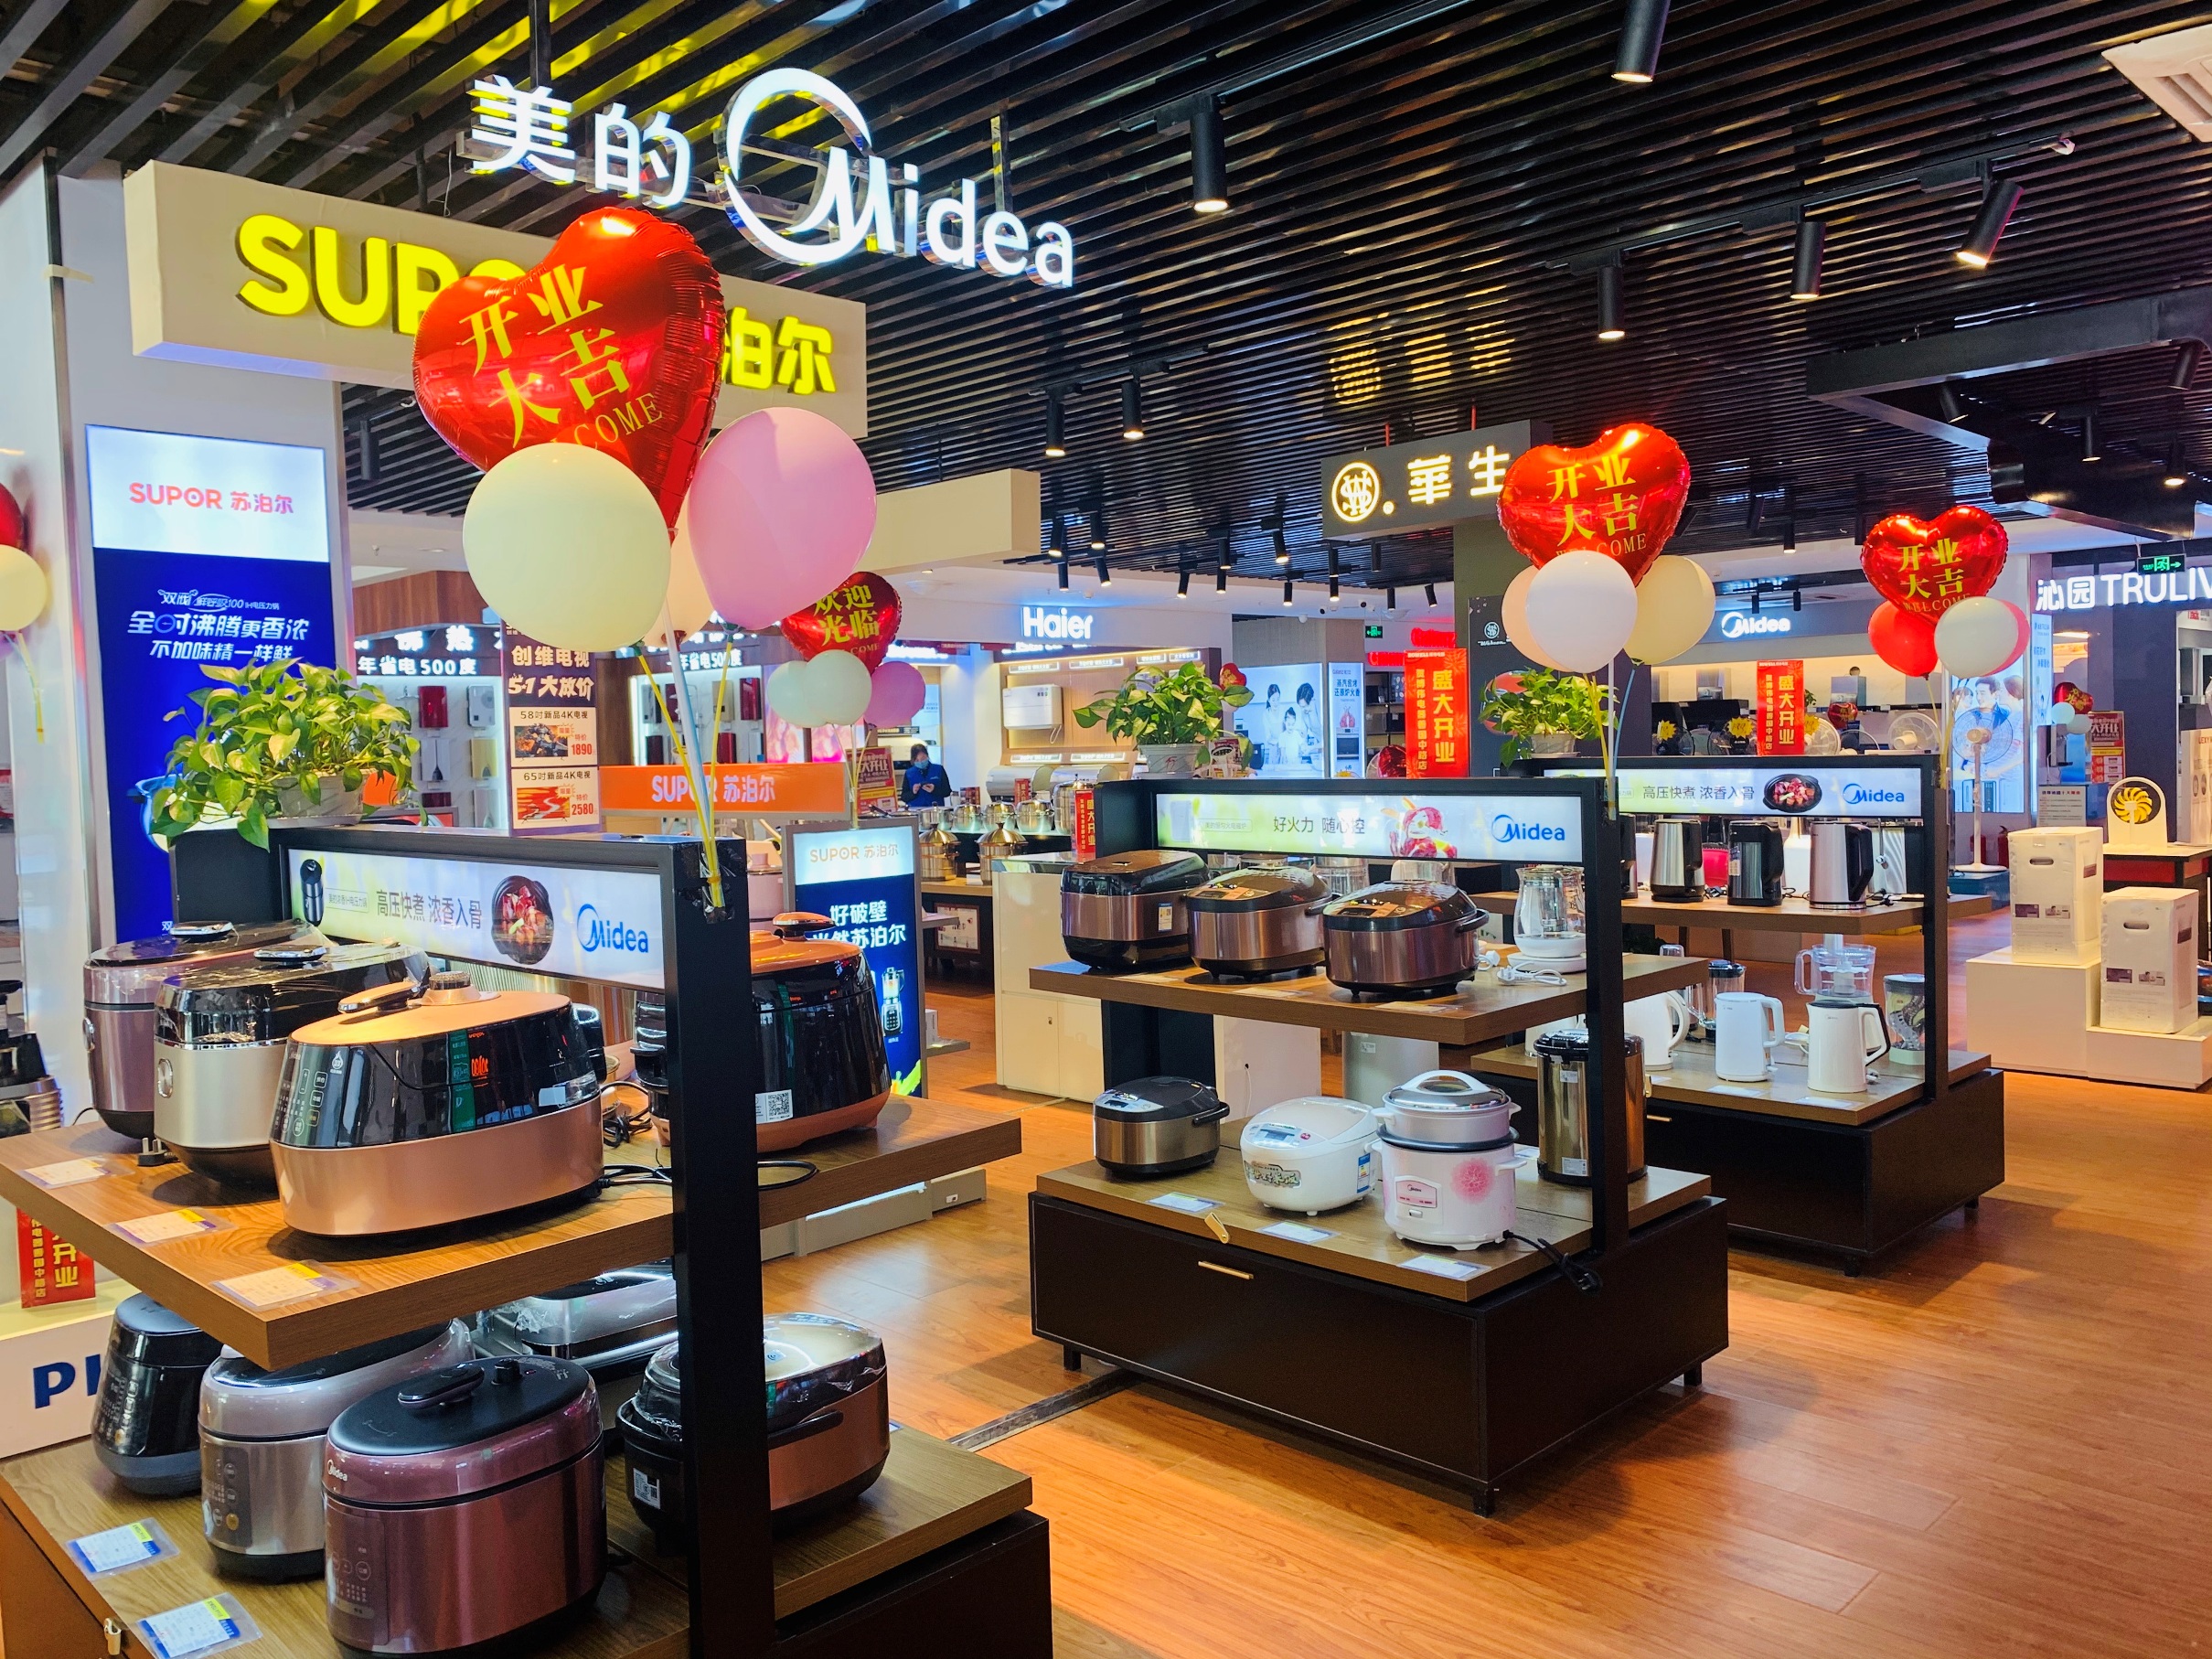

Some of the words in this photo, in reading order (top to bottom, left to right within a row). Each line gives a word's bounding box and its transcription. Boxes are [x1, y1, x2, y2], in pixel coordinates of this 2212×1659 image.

[468, 75, 693, 207] 美的
[727, 68, 1075, 287] Midea
[235, 212, 530, 335] SUP
[721, 305, 838, 396] 泊尔
[456, 263, 604, 376] 开业
[487, 330, 632, 449] 大吉
[550, 392, 664, 447] COME
[1545, 454, 1637, 504] 开业
[129, 482, 223, 510] SUPOR
[230, 490, 294, 515] 苏泊尔
[1554, 492, 1640, 547] 大吉
[1897, 537, 1963, 573] 开业
[1899, 567, 1965, 599] 大吉
[2035, 575, 2095, 612] 沁园
[813, 583, 875, 617] 欢迎
[820, 609, 881, 647] 光临
[1022, 605, 1095, 639] Haier
[1721, 611, 1791, 638] Midea
[149, 639, 294, 662] 不加味精一样鲜
[511, 645, 591, 668] 创维电视
[538, 675, 595, 701] 大放价
[1432, 669, 1456, 764] 盛大开业
[1779, 674, 1795, 744] 盛大开业
[571, 744, 593, 755] 1890
[723, 775, 776, 803] 苏泊尔
[1642, 786, 1696, 800] 高压快煮
[1699, 786, 1755, 800] 浓香入骨
[1843, 783, 1905, 805] Midea
[572, 803, 594, 815] 2580
[1273, 816, 1314, 833] 好火力
[1321, 817, 1365, 834] 随心控
[1491, 814, 1565, 843] Midea
[809, 847, 860, 863] SUPOR
[863, 843, 899, 859] 苏泊尔
[376, 889, 425, 922] 高压快煮
[428, 894, 483, 930] 浓香入骨
[829, 900, 888, 927] 好破壁
[576, 903, 649, 954] Midea
[327, 1459, 347, 1482] Midea
